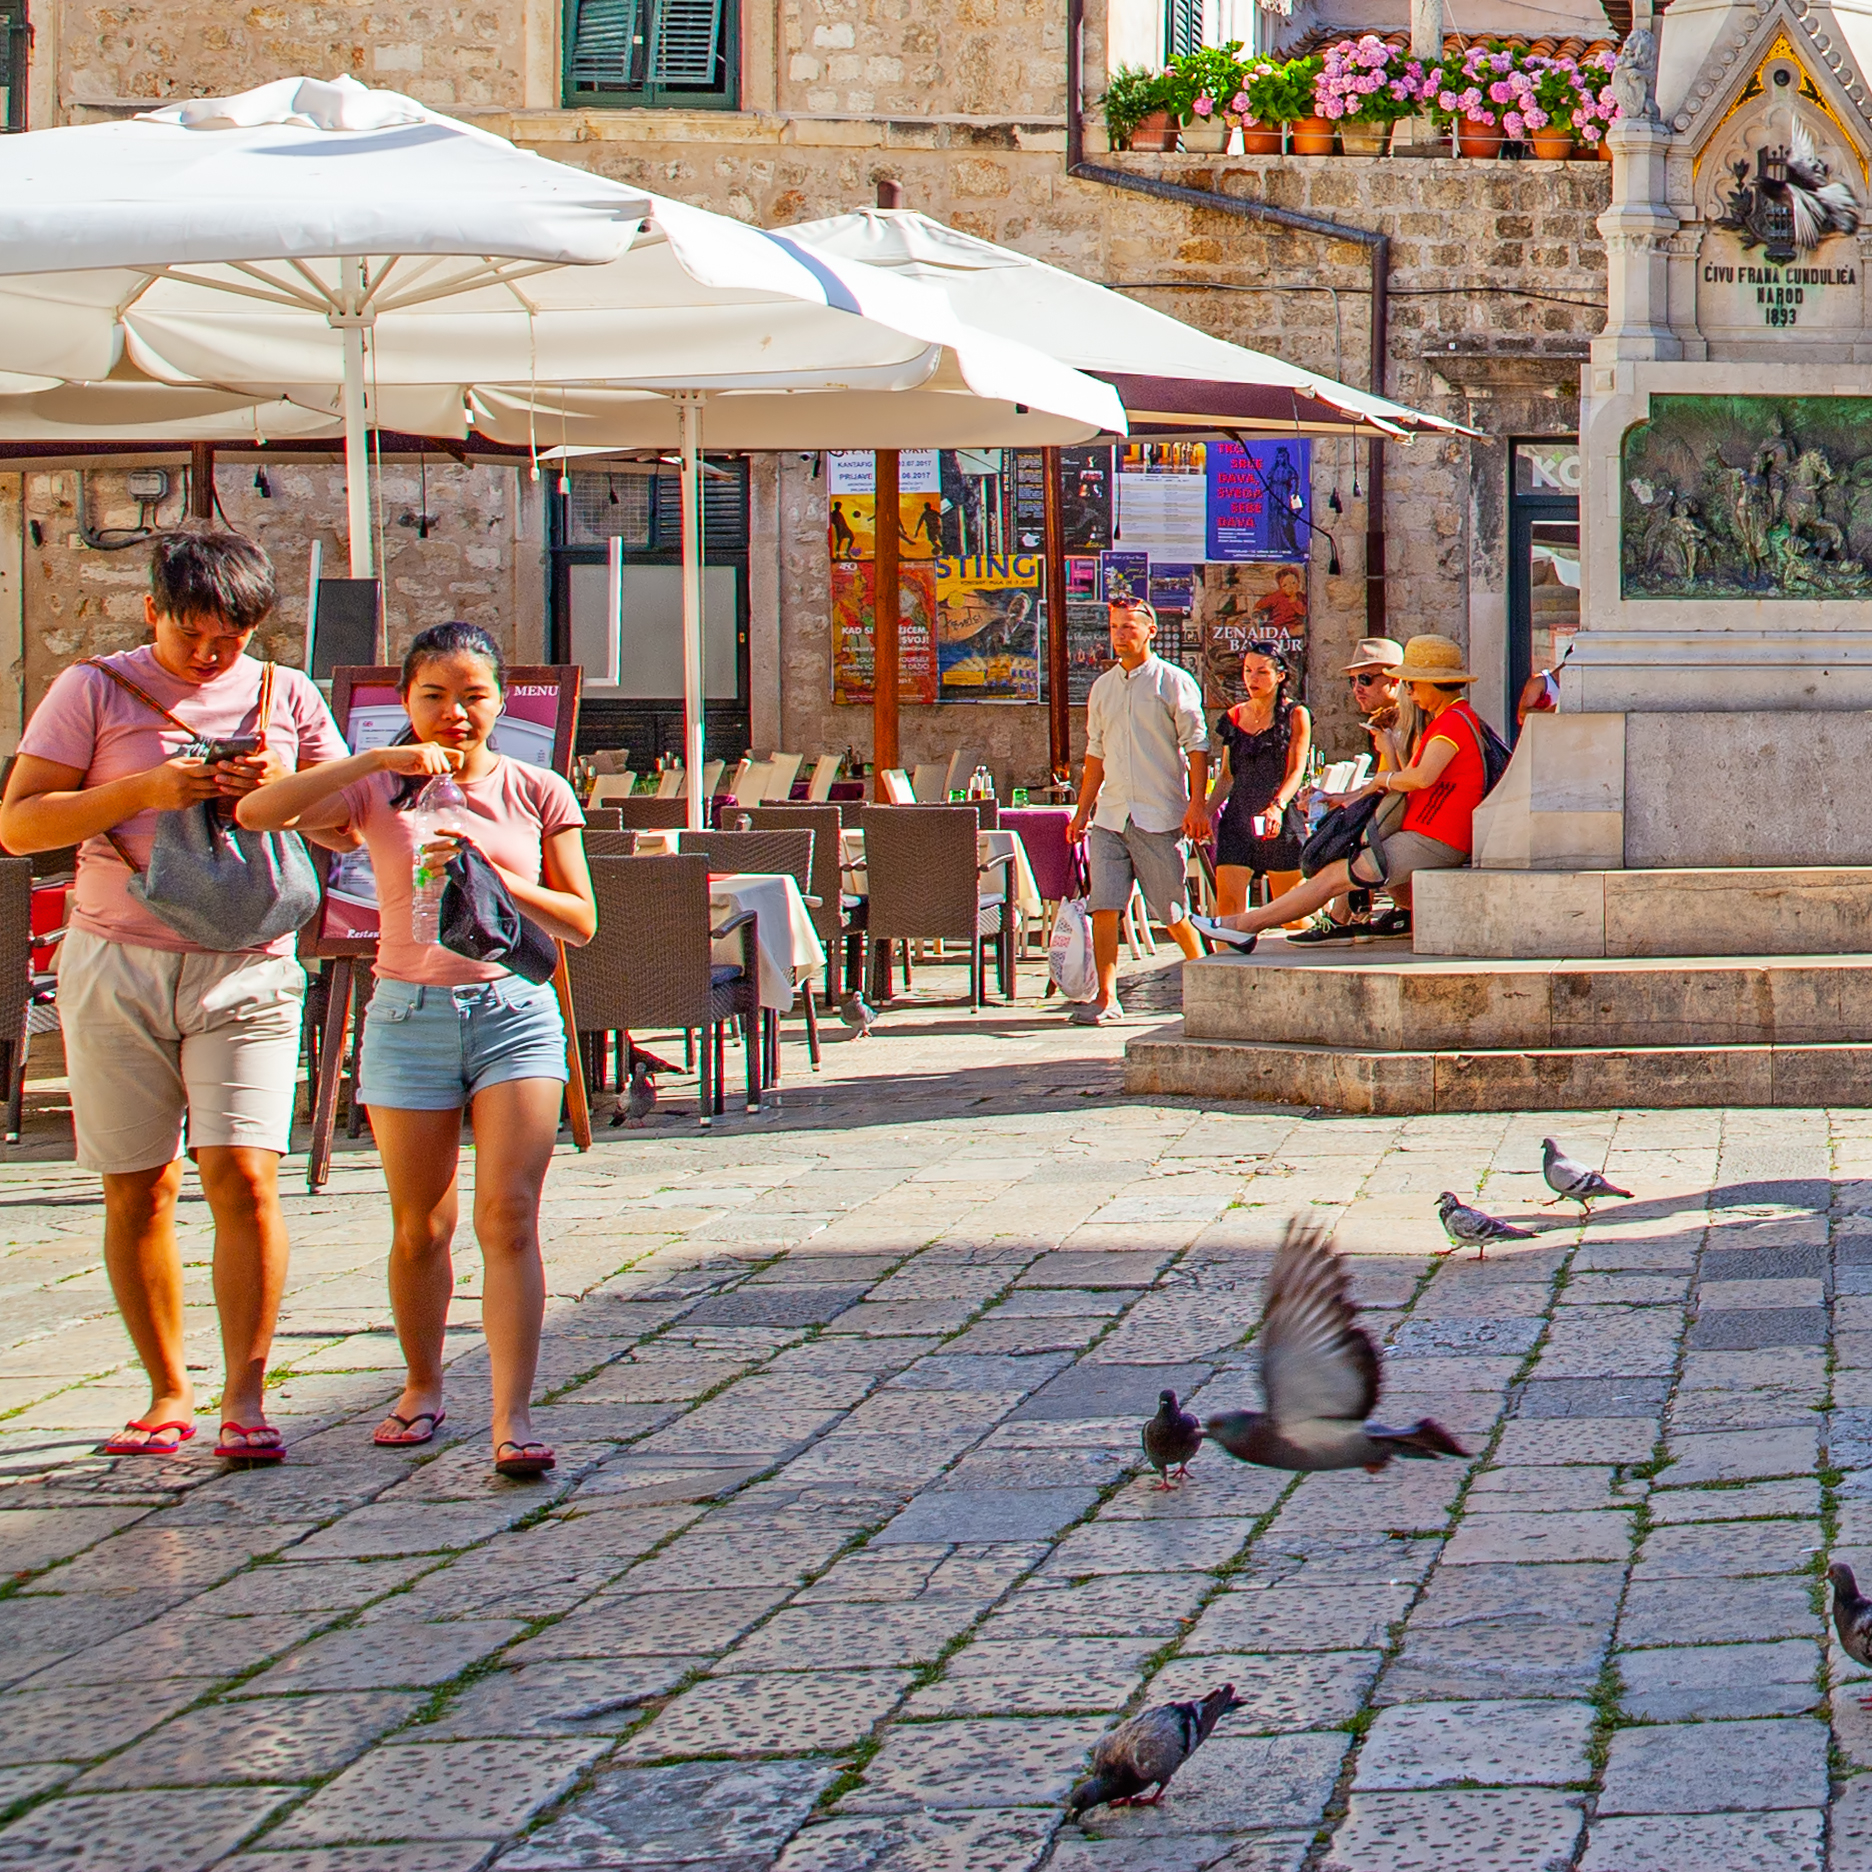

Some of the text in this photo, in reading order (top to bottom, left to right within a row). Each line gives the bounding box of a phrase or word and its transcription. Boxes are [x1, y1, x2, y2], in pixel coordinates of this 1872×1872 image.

[1738, 266, 1780, 285] FRANA
[1756, 286, 1804, 305] NAROD
[1765, 307, 1797, 325] 1893
[936, 553, 1036, 578] STING
[841, 626, 862, 635] KAD
[1212, 626, 1291, 639] ZENAIDA
[514, 684, 559, 697] MENU
